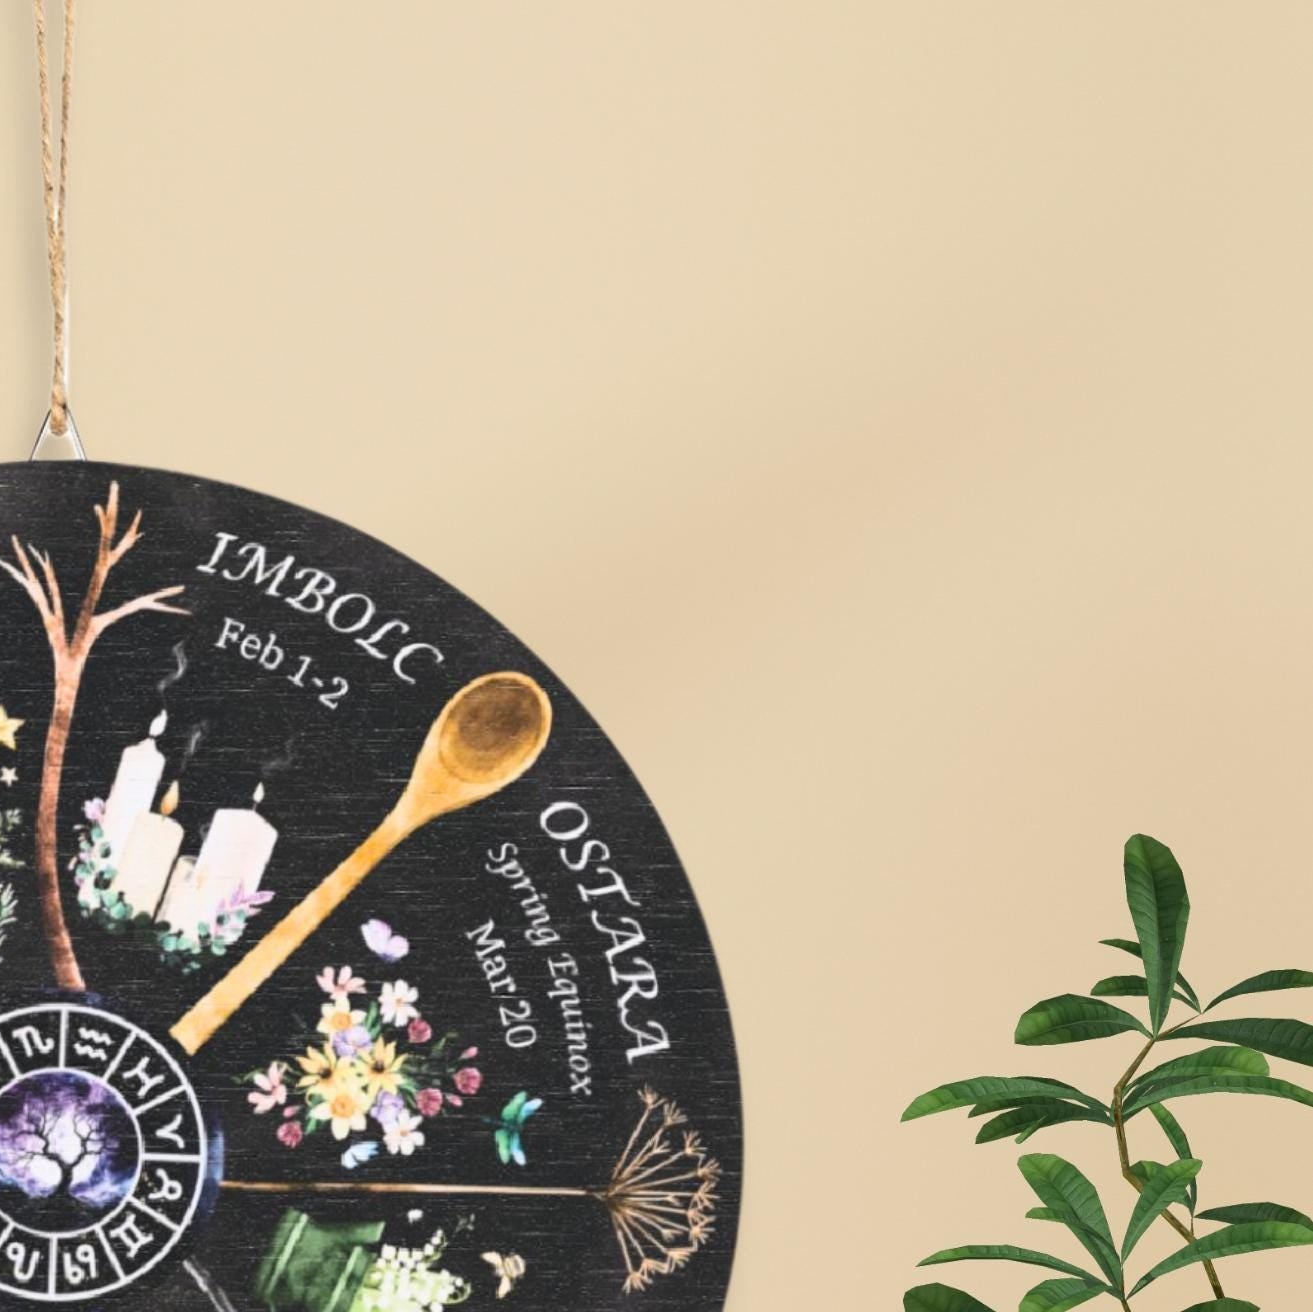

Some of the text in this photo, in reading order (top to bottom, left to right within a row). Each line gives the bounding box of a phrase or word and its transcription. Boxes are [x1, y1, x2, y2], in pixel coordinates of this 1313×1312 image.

[197, 532, 444, 685] IMBOLC
[215, 617, 349, 710] Feb 1-2
[465, 919, 537, 1048] Mar 20
[485, 842, 593, 1095] Spring Equinox
[540, 801, 670, 1065] OSTARA
